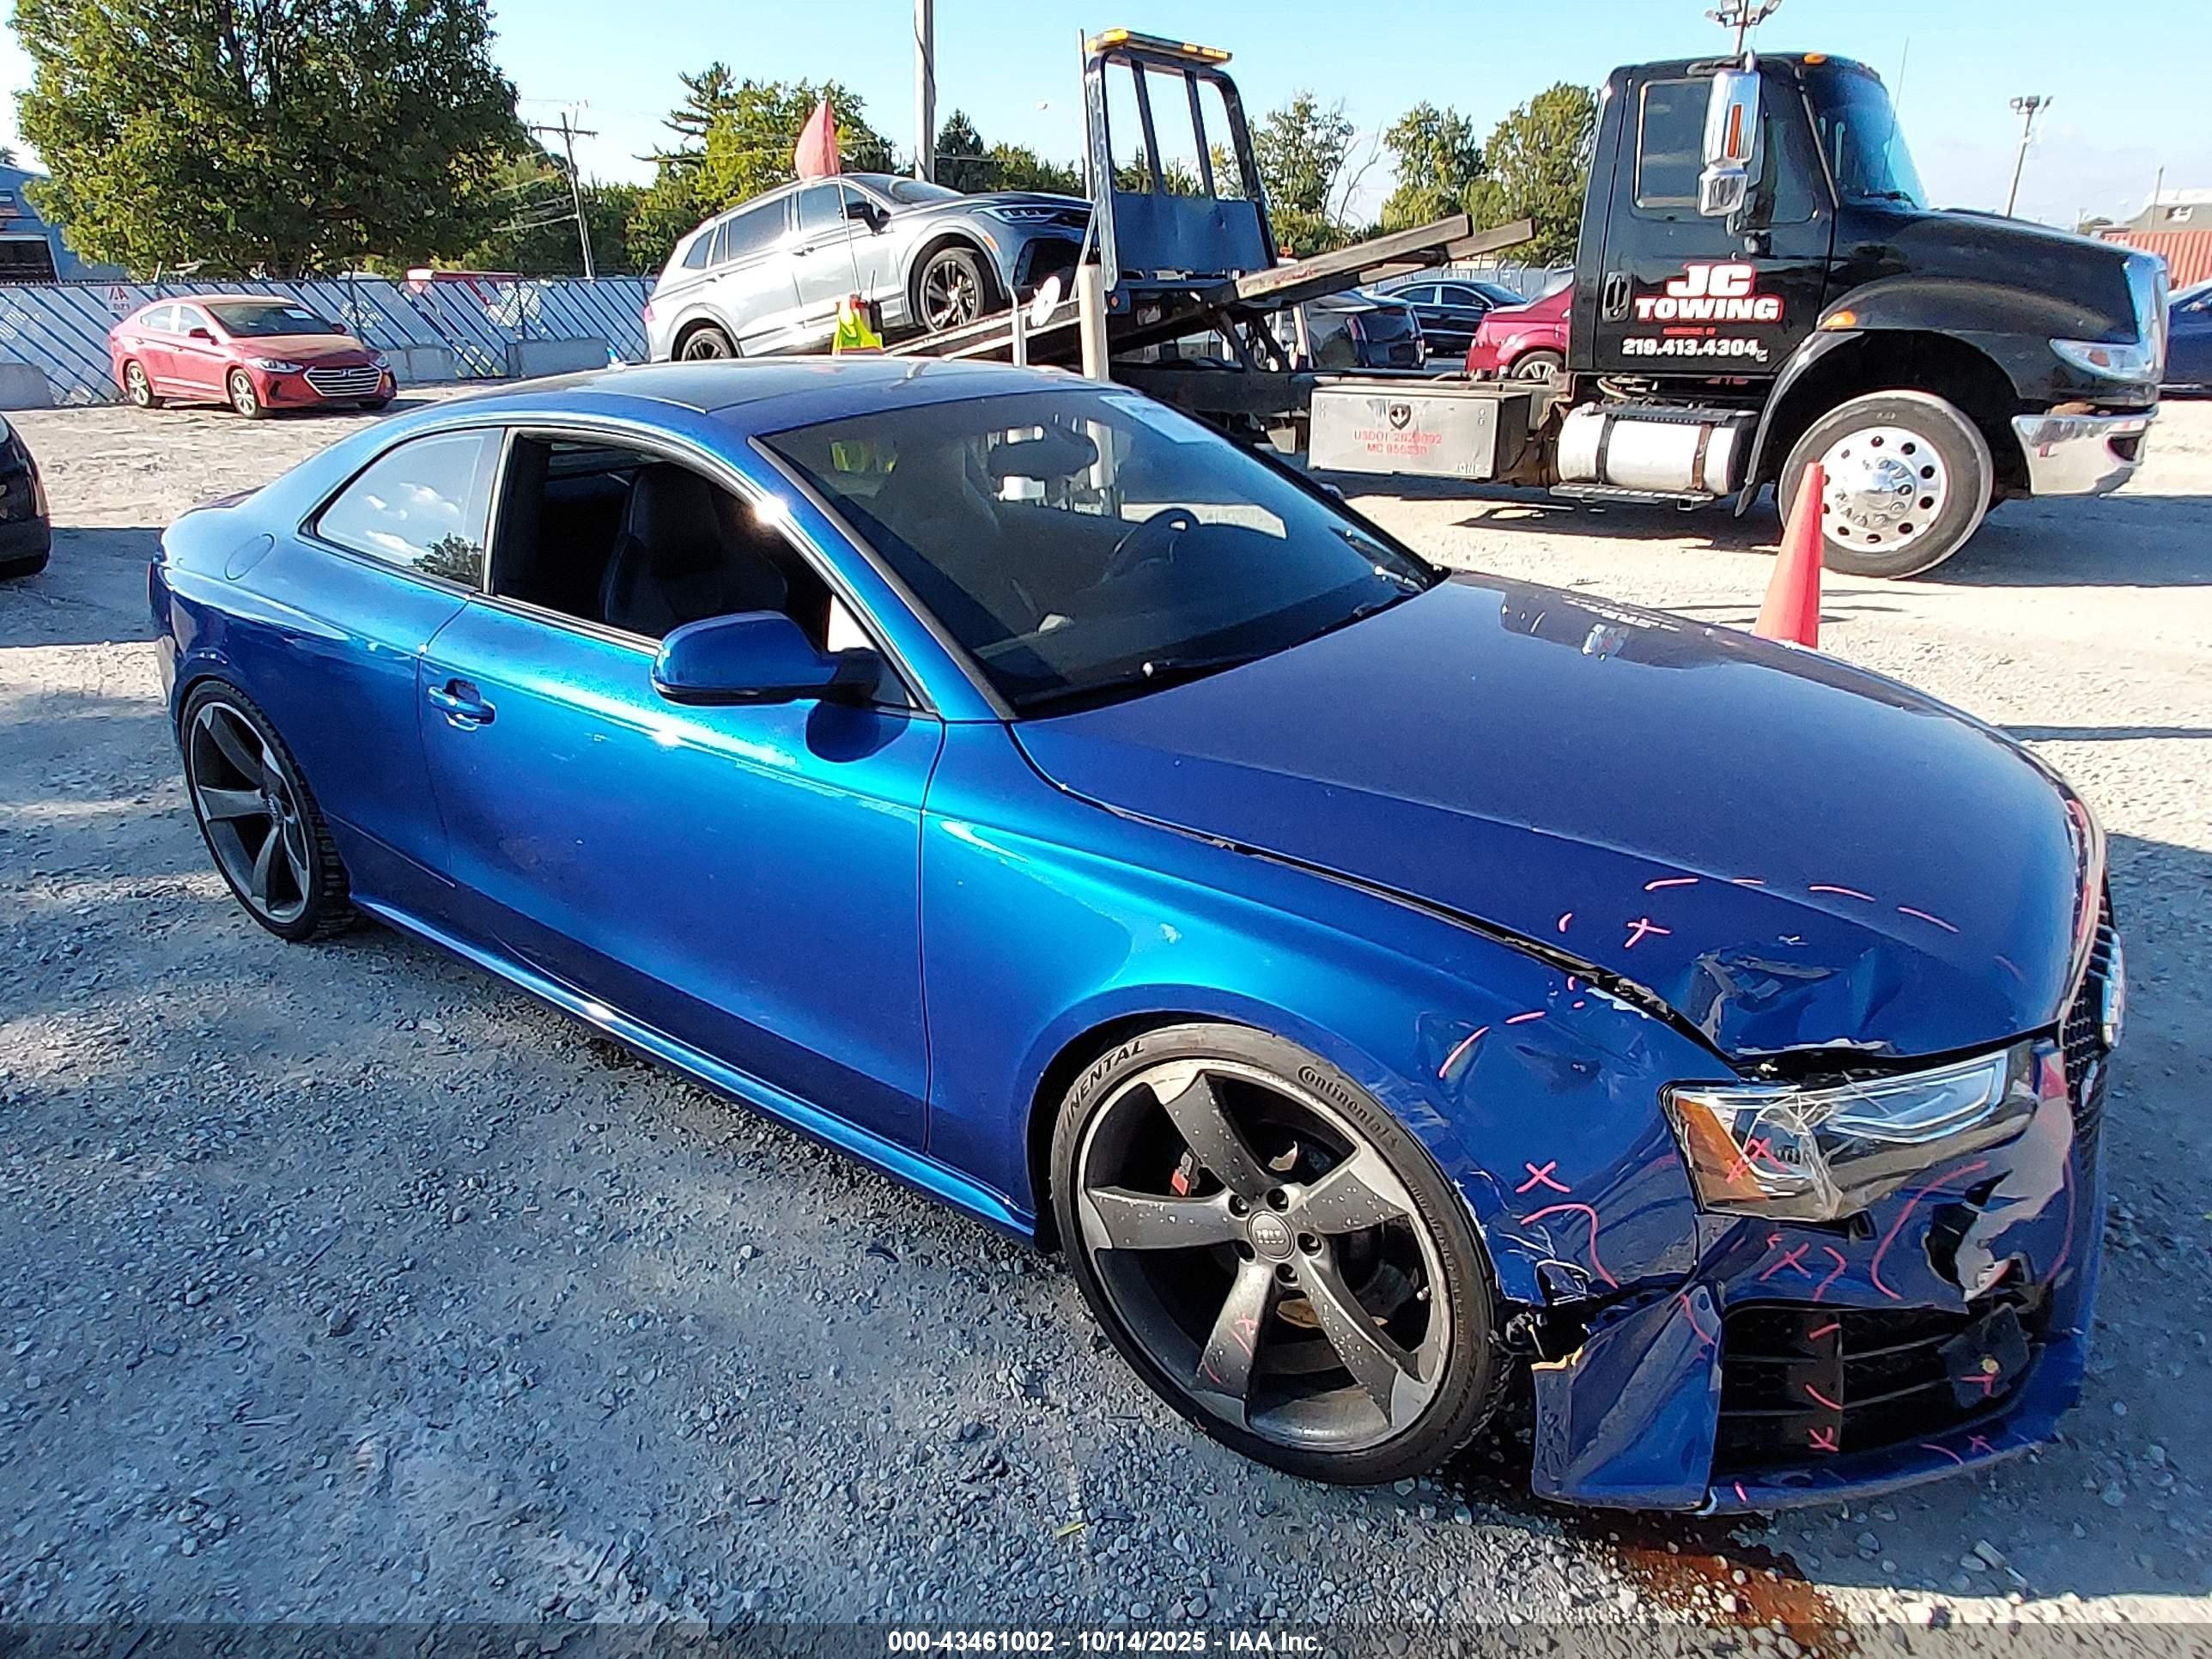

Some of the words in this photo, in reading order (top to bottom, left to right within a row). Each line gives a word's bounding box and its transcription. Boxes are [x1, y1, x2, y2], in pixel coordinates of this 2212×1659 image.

[1666, 264, 1753, 297] JC
[1634, 298, 1779, 320] TOWING
[1622, 337, 1759, 356] 219.413.4304
